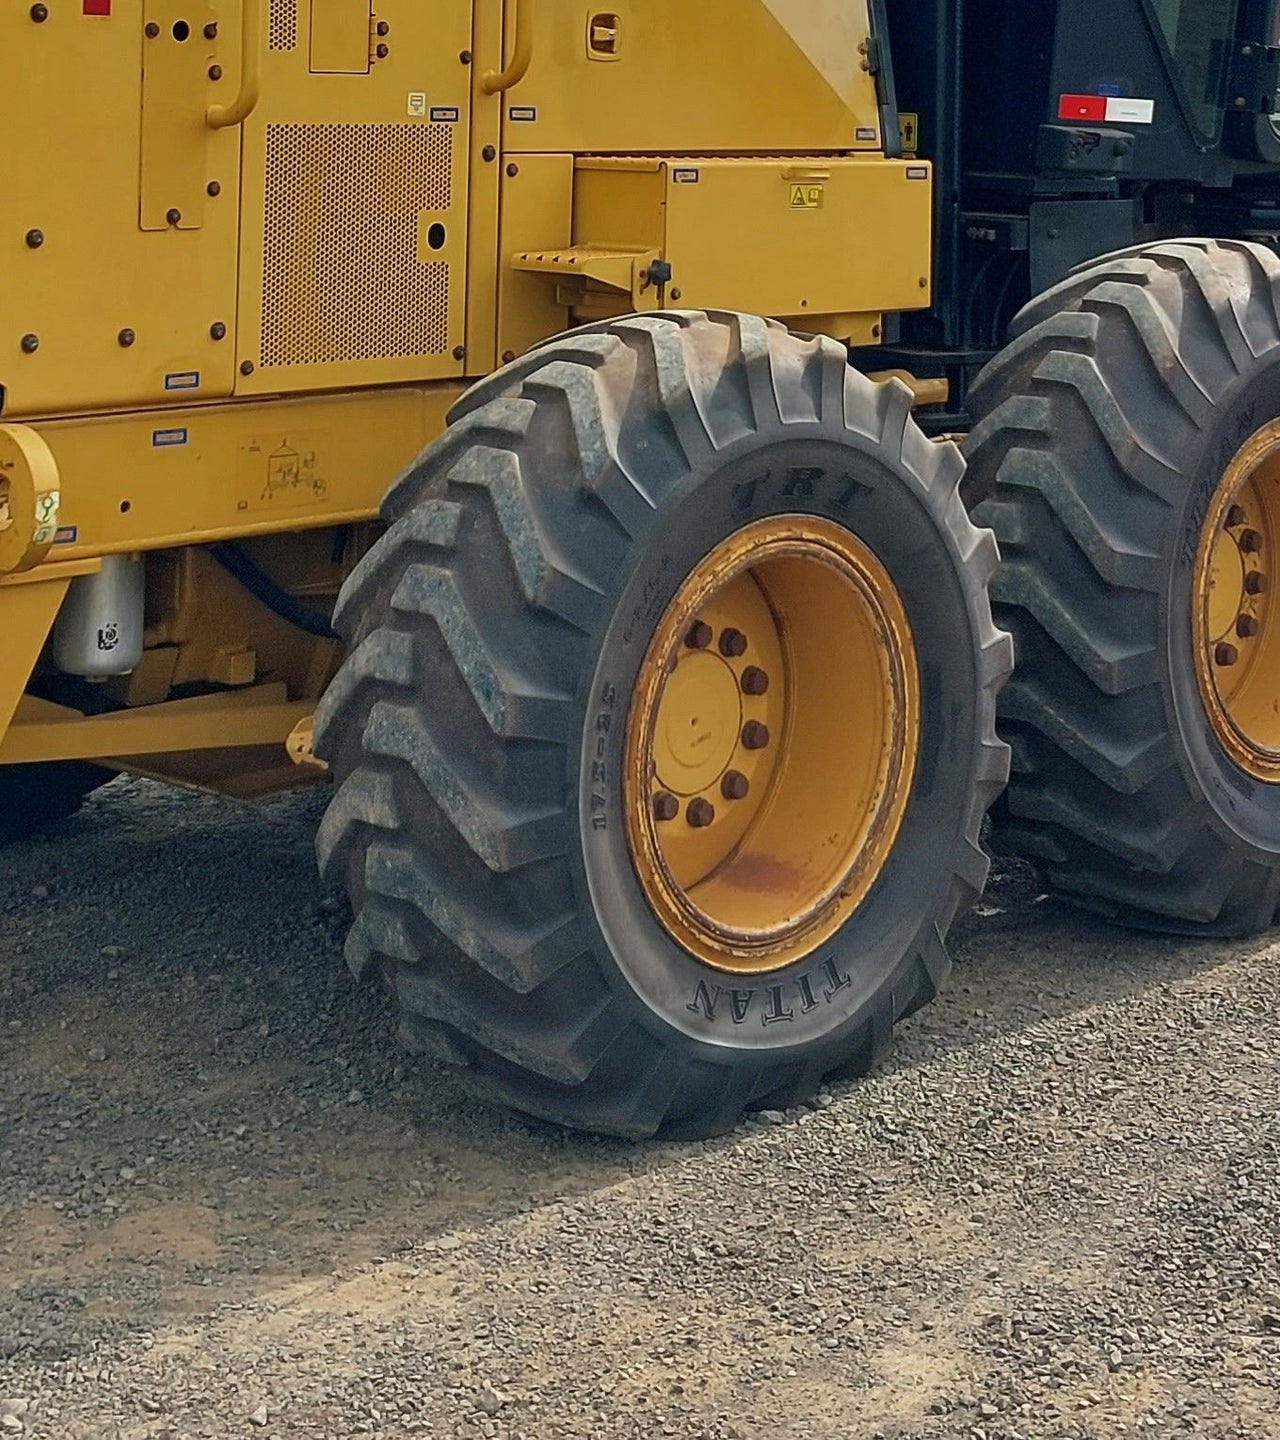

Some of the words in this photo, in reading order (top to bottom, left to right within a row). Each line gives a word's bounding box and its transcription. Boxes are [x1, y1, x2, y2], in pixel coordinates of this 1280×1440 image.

[730, 465, 877, 512] TRT
[591, 680, 616, 831] 17.5-25
[686, 953, 852, 1028] TITAN
